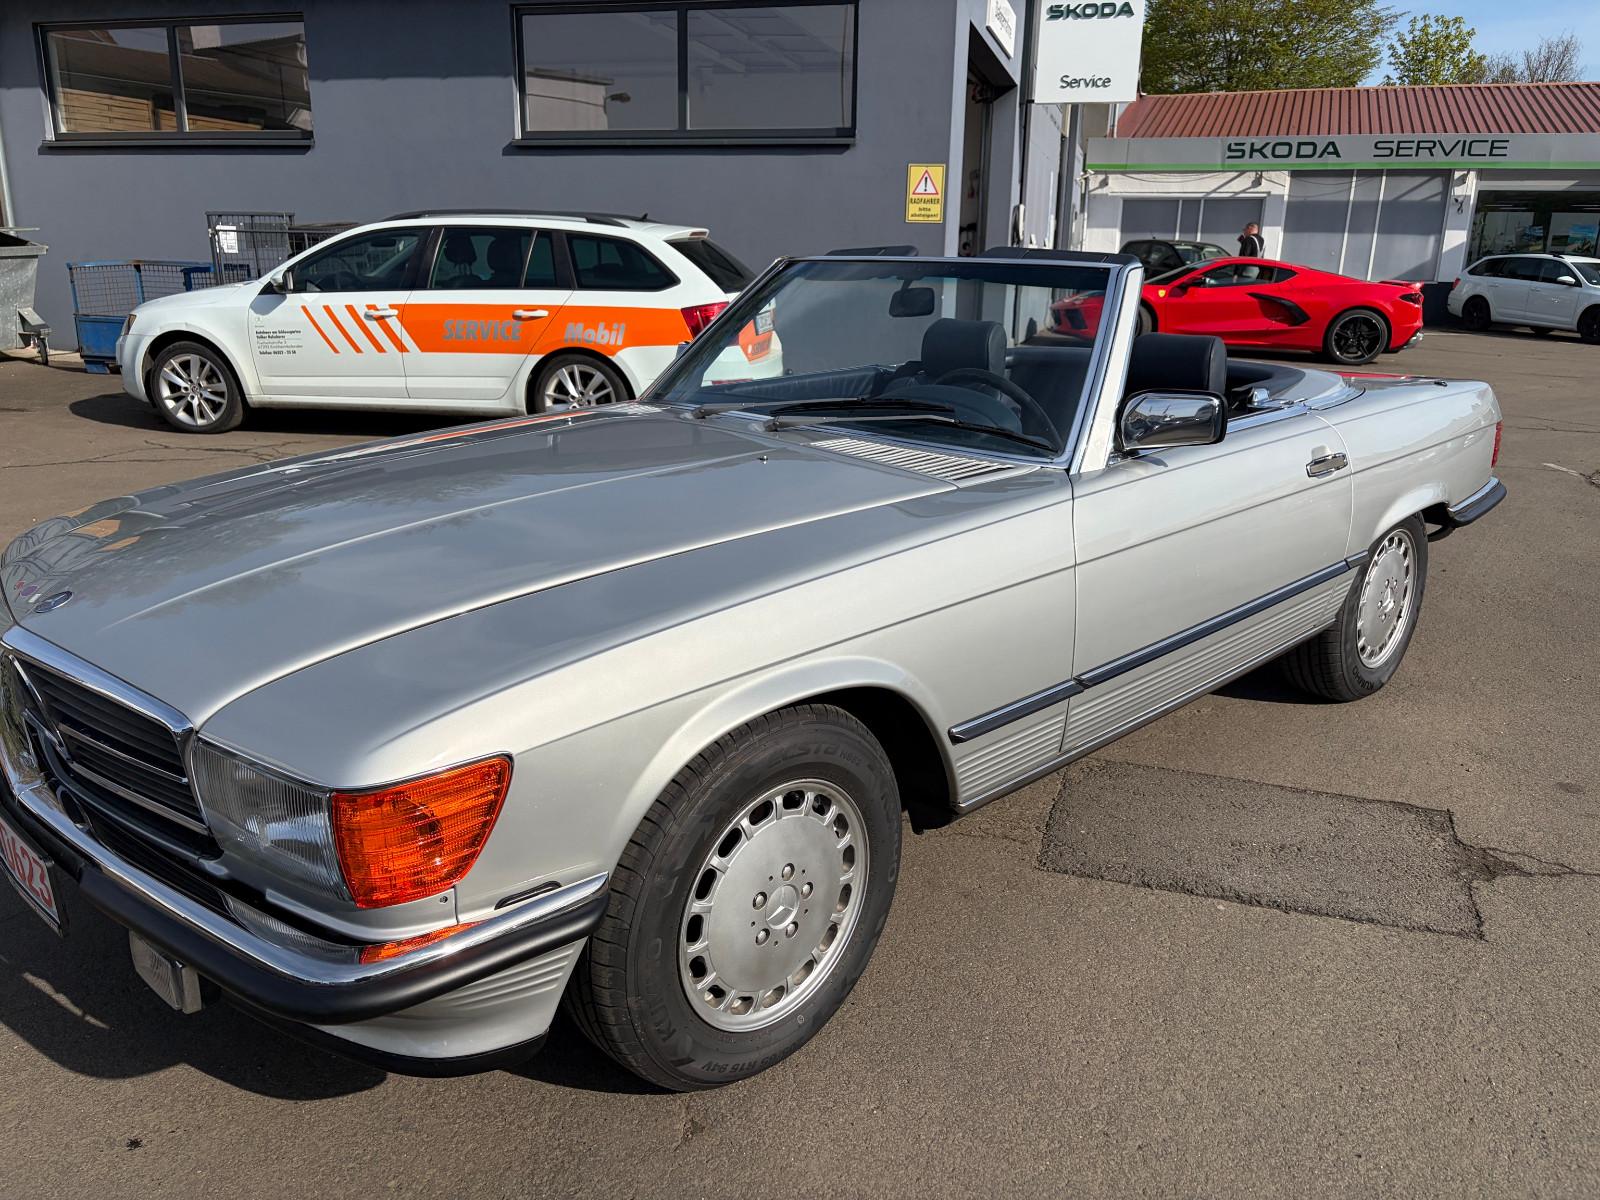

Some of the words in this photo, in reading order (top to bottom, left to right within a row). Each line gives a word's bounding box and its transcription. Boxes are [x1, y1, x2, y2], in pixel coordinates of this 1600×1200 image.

[1059, 74, 1112, 89] Service
[1373, 139, 1510, 158] SERVICE
[442, 319, 523, 342] SERVICE
[563, 321, 626, 346] Mobil
